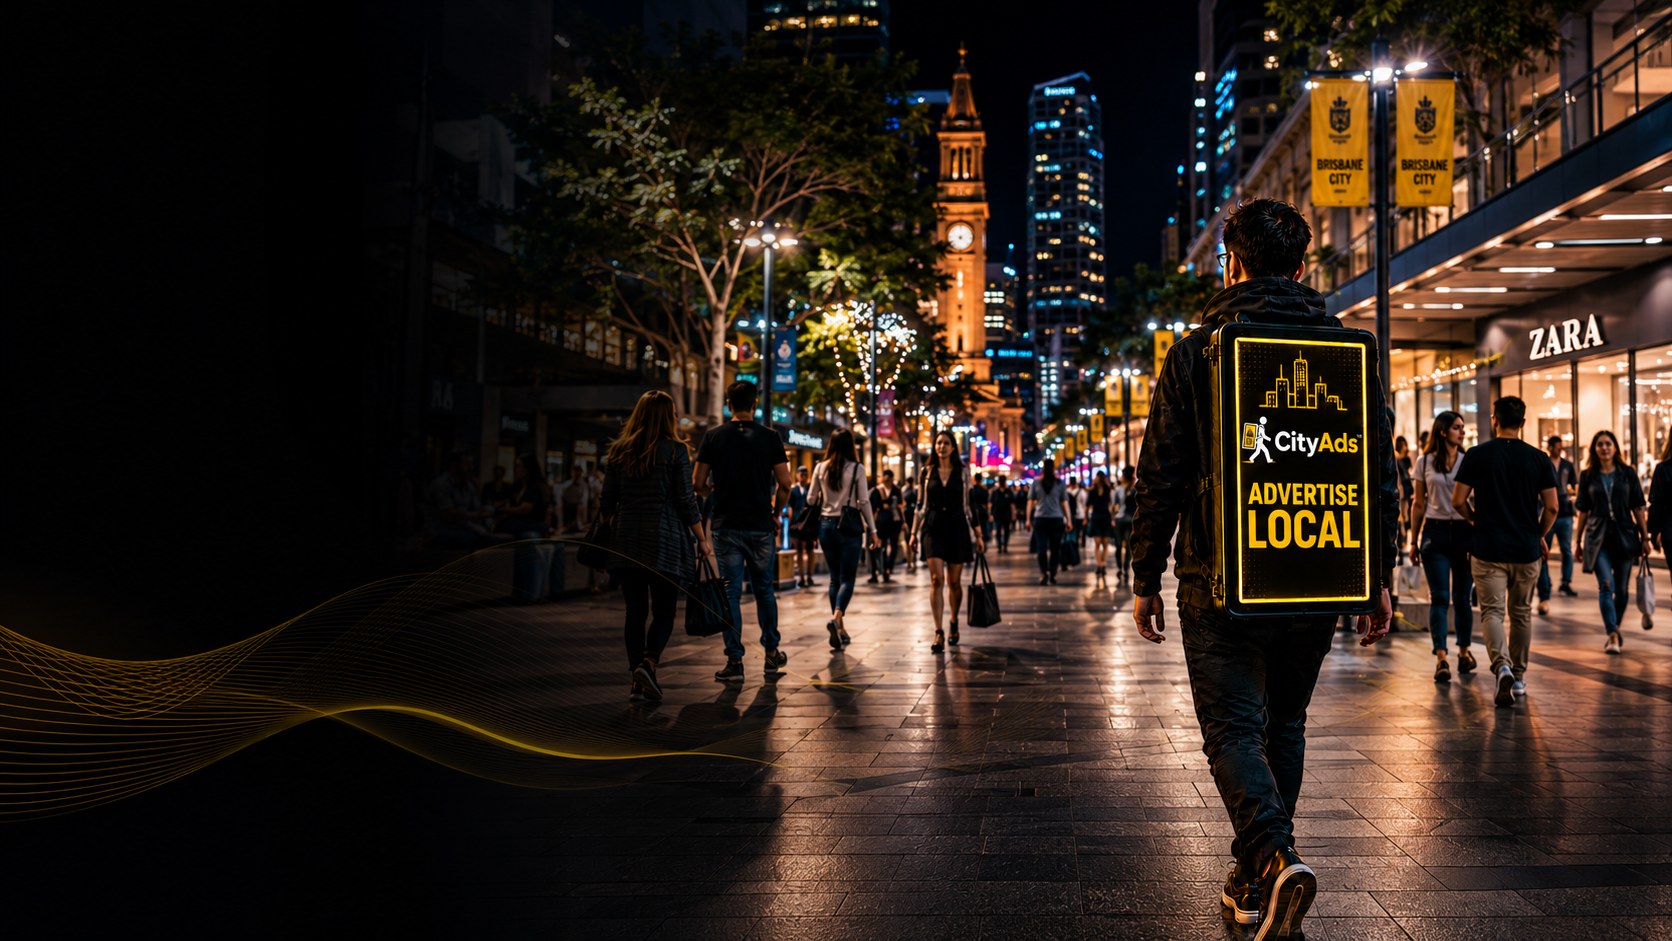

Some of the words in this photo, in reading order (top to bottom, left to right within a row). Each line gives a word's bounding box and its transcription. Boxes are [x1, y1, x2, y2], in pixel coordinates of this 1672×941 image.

[1317, 159, 1363, 170] BRISBANE
[1401, 159, 1448, 171] BRISBANE
[1329, 173, 1352, 185] CITY
[1413, 173, 1436, 185] CITY
[1529, 313, 1604, 361] ZARA
[1274, 430, 1359, 457] CityAds
[1248, 482, 1359, 506] ADVERTISE
[1248, 509, 1361, 549] LOCAL
